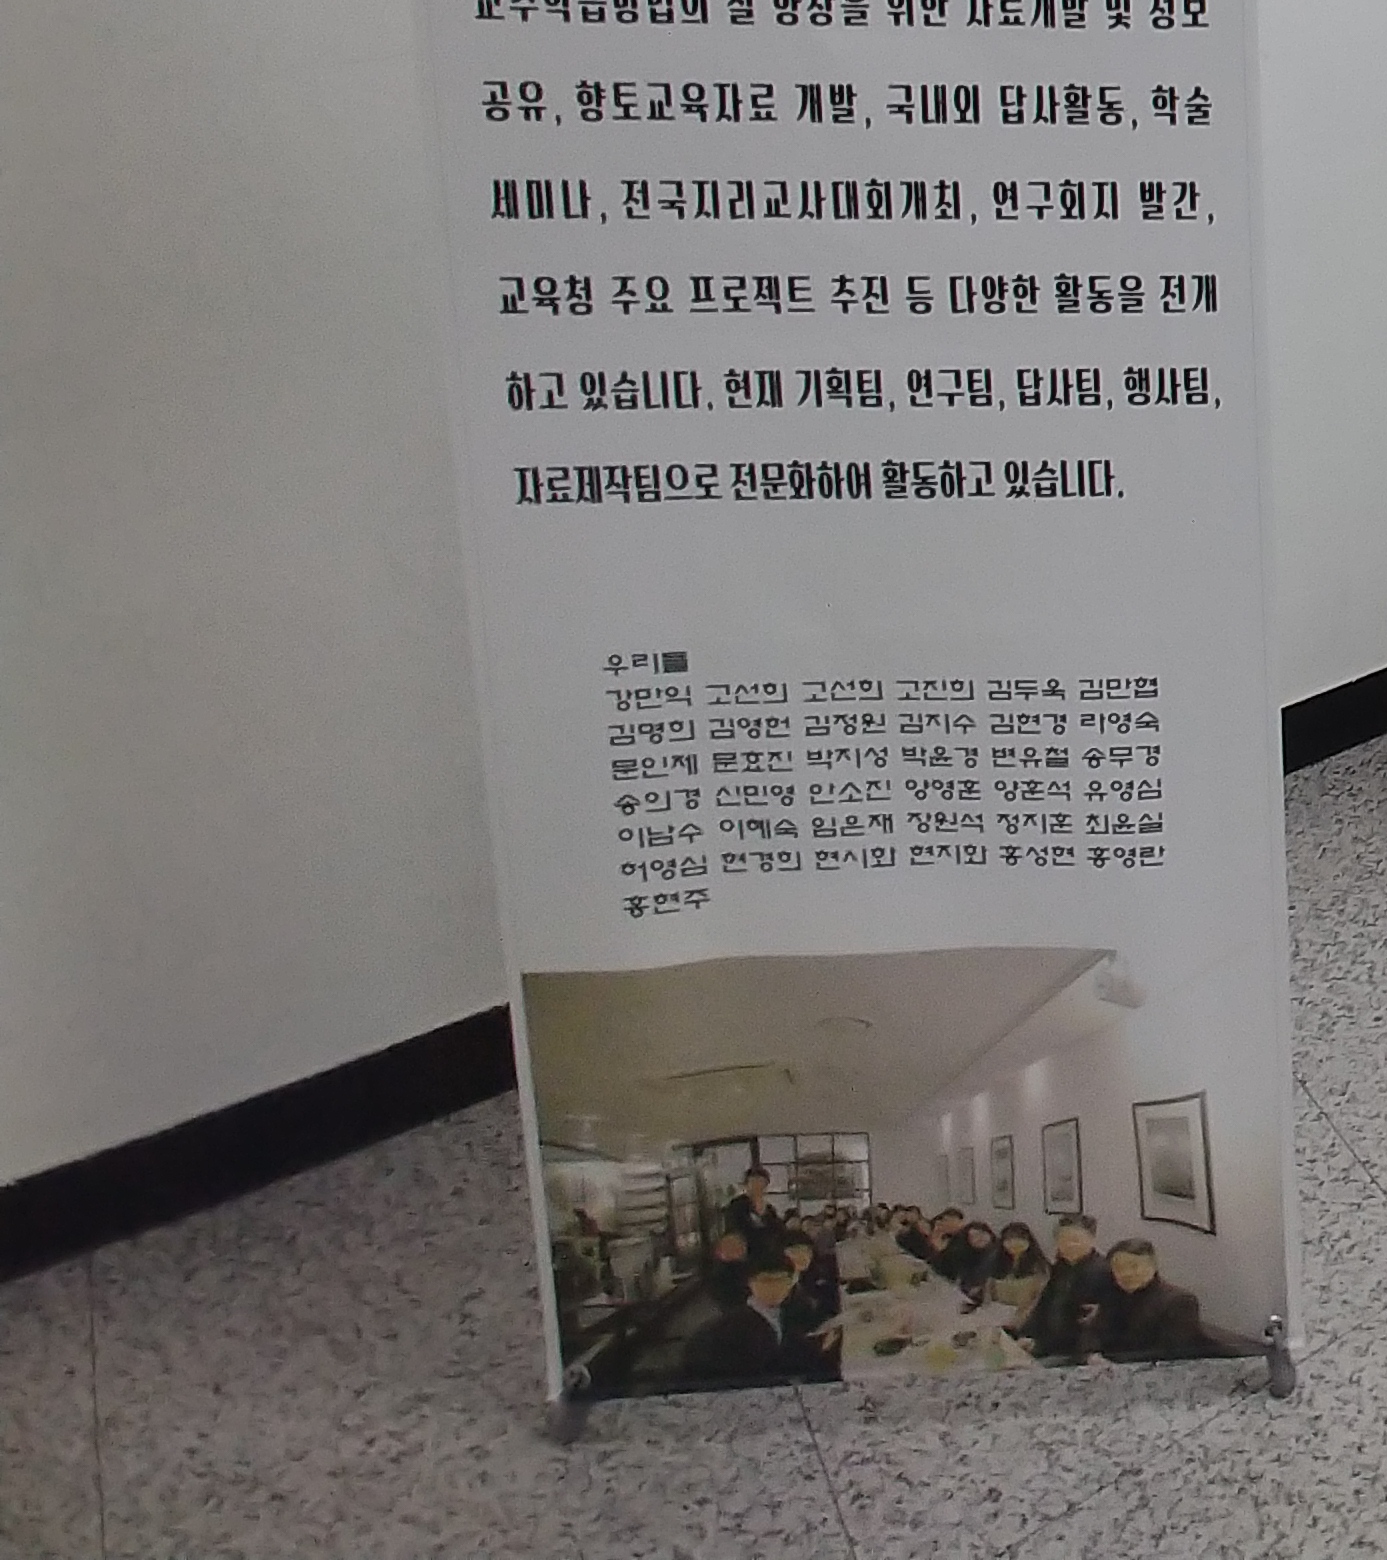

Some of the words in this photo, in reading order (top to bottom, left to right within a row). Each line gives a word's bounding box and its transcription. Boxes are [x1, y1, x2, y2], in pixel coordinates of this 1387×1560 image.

[481, 80, 562, 127] 공유,
[575, 79, 778, 123] 향토교육자료
[794, 83, 872, 130] 개발,
[886, 84, 980, 125] 국내외
[999, 83, 1138, 131] 답사활동,
[1151, 84, 1213, 126] 학술
[491, 179, 607, 225] 세미나,
[620, 177, 977, 226] 전국지리교사대회개최,
[992, 178, 1119, 221] 연구회지
[1139, 181, 1214, 225] 발간,
[499, 274, 593, 316] 교육청
[611, 275, 674, 316] 주요
[689, 275, 816, 315] 프로젝트
[830, 274, 890, 315] 추진
[905, 275, 934, 315] 등
[949, 273, 1041, 315] 다양한
[1053, 272, 1146, 314] 활동을
[1159, 274, 1218, 314] 전개
[505, 370, 569, 412] 하고
[579, 370, 714, 412] 있습니다.
[723, 368, 783, 409] 현재
[795, 366, 895, 413] 기획팀,
[907, 368, 1005, 412] 연구팀,
[1016, 367, 1113, 411] 답사팀,
[1123, 366, 1221, 410] 행사팀,
[513, 463, 723, 505] 자료제작팀으로
[729, 459, 872, 501] 전문화하여
[881, 458, 996, 500] 활동하고
[1004, 459, 1124, 499] 있습니다.
[605, 685, 693, 712] 강만익
[705, 682, 789, 706] 고선희
[801, 678, 884, 703] 고선희
[895, 678, 975, 701] 고진희
[987, 678, 1066, 702] 김두옥
[1078, 676, 1159, 701] 김만협
[607, 719, 696, 747] 김명희
[804, 712, 887, 737] 김정원
[897, 712, 977, 735] 김지수
[989, 712, 1068, 736] 김현경
[611, 753, 699, 781] 문인제
[712, 750, 794, 774] 문효진
[806, 746, 889, 770] 박지성
[1081, 744, 1161, 769] 송무경
[613, 787, 701, 817] 송의경
[715, 784, 795, 807] 신민영
[809, 779, 892, 805] 안소진
[904, 779, 982, 801] 양영훈
[994, 779, 1071, 802] 양훈석
[1083, 778, 1163, 803] 유영심
[617, 822, 704, 849] 이남수
[907, 811, 985, 834] 장원석
[996, 812, 1073, 835] 정지훈
[1085, 811, 1163, 835] 최윤실
[620, 854, 708, 883] 허영심
[1086, 845, 1166, 869] 홍영란
